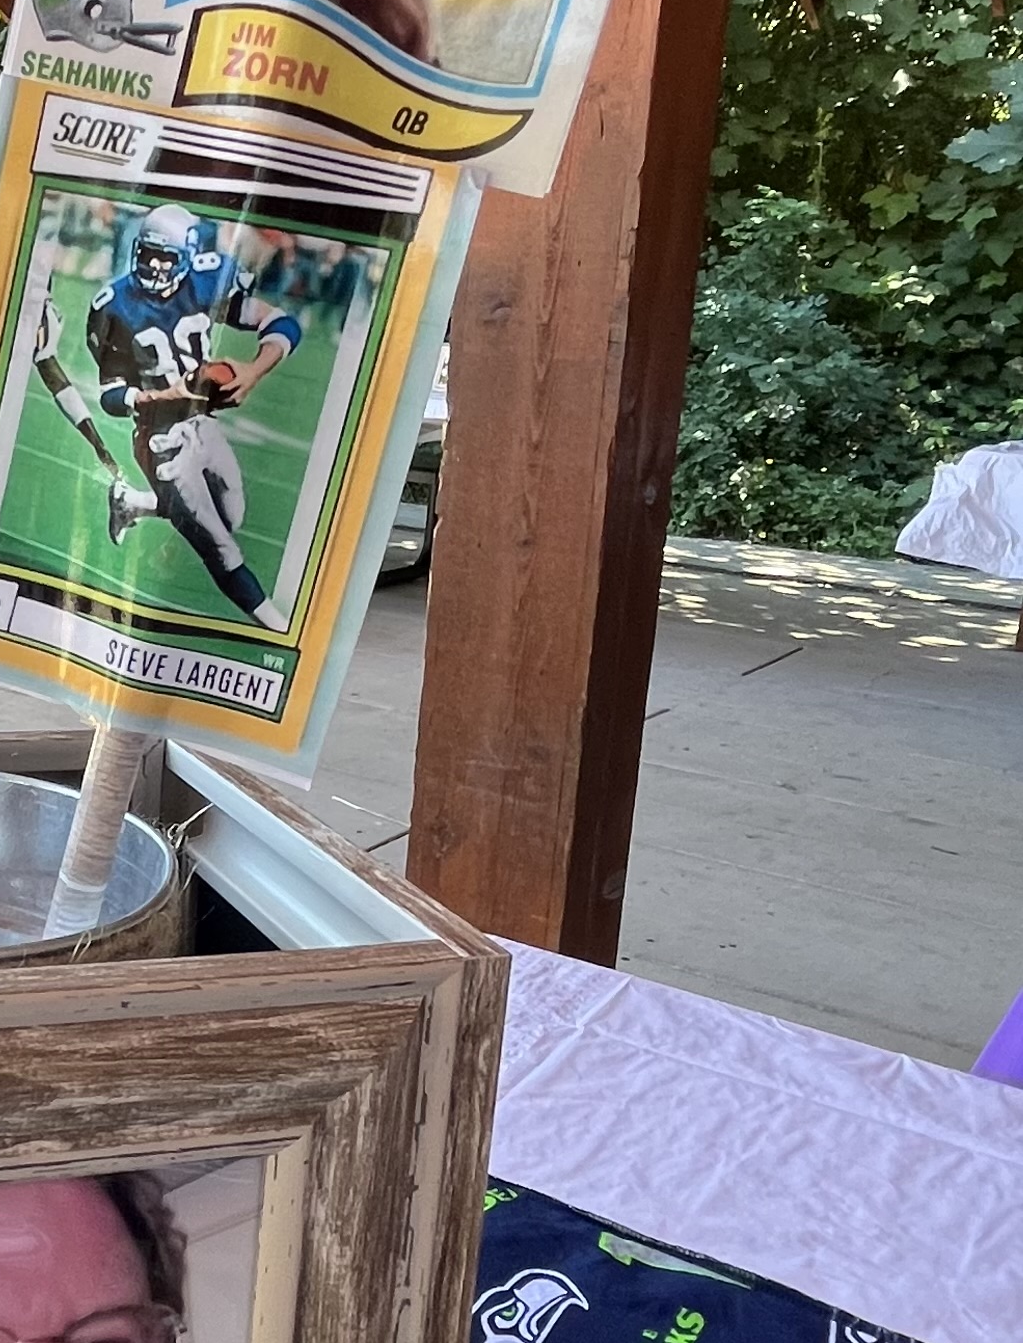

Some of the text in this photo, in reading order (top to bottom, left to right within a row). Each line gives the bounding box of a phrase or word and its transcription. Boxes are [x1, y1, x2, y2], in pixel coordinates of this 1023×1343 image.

[229, 23, 275, 49] JIM
[21, 50, 154, 100] SEAHAWKS
[222, 48, 330, 95] ZORN
[52, 111, 146, 157] SCORE
[391, 105, 429, 135] QB
[104, 638, 277, 705] STEVE LARGENT
